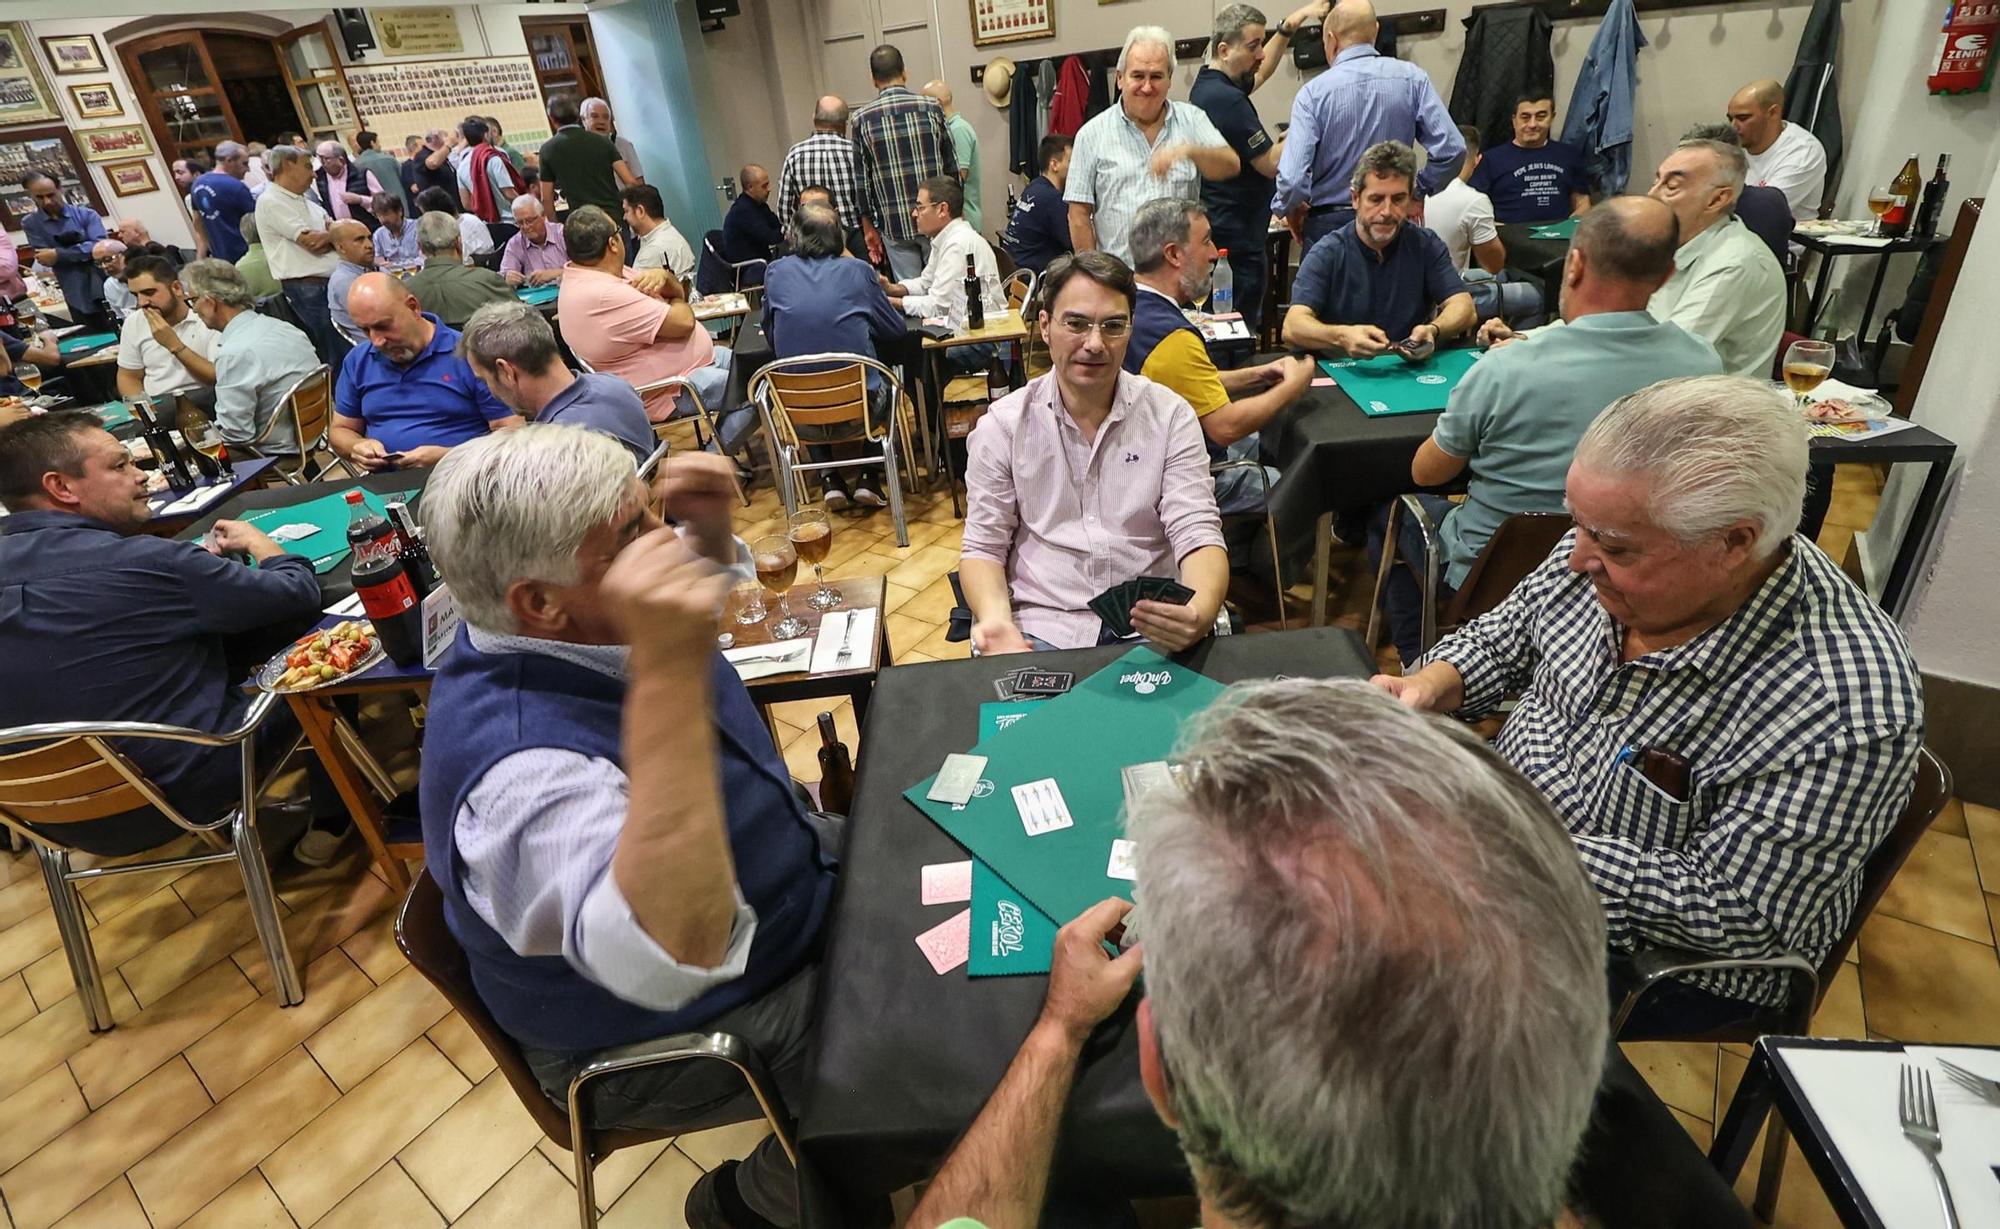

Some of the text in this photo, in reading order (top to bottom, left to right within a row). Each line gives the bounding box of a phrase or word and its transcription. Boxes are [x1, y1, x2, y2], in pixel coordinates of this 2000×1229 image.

[1946, 49, 1987, 59] ZENITH
[1513, 166, 1527, 177] PEPE
[1544, 163, 1564, 174] LONDON
[998, 900, 1024, 957] CEROL
